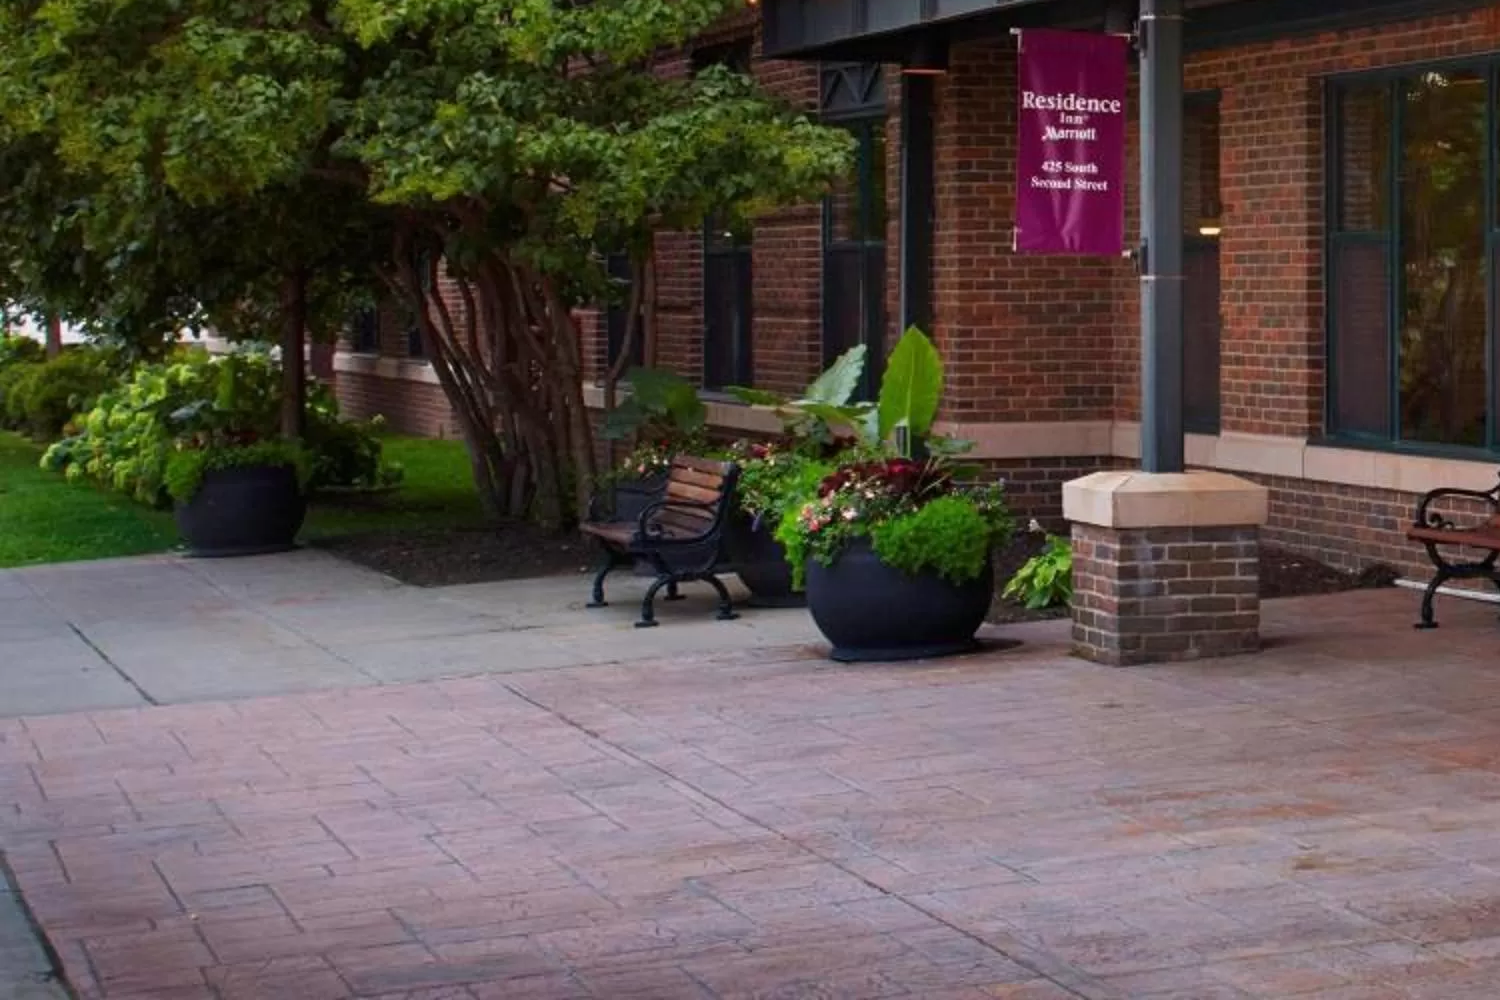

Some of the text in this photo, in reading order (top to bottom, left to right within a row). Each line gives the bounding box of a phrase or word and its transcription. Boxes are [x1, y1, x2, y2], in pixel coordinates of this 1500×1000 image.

[1022, 91, 1120, 113] Residence
[1041, 126, 1097, 141] Marriott
[1041, 160, 1098, 174] 425 South
[1031, 176, 1108, 191] Second Street
